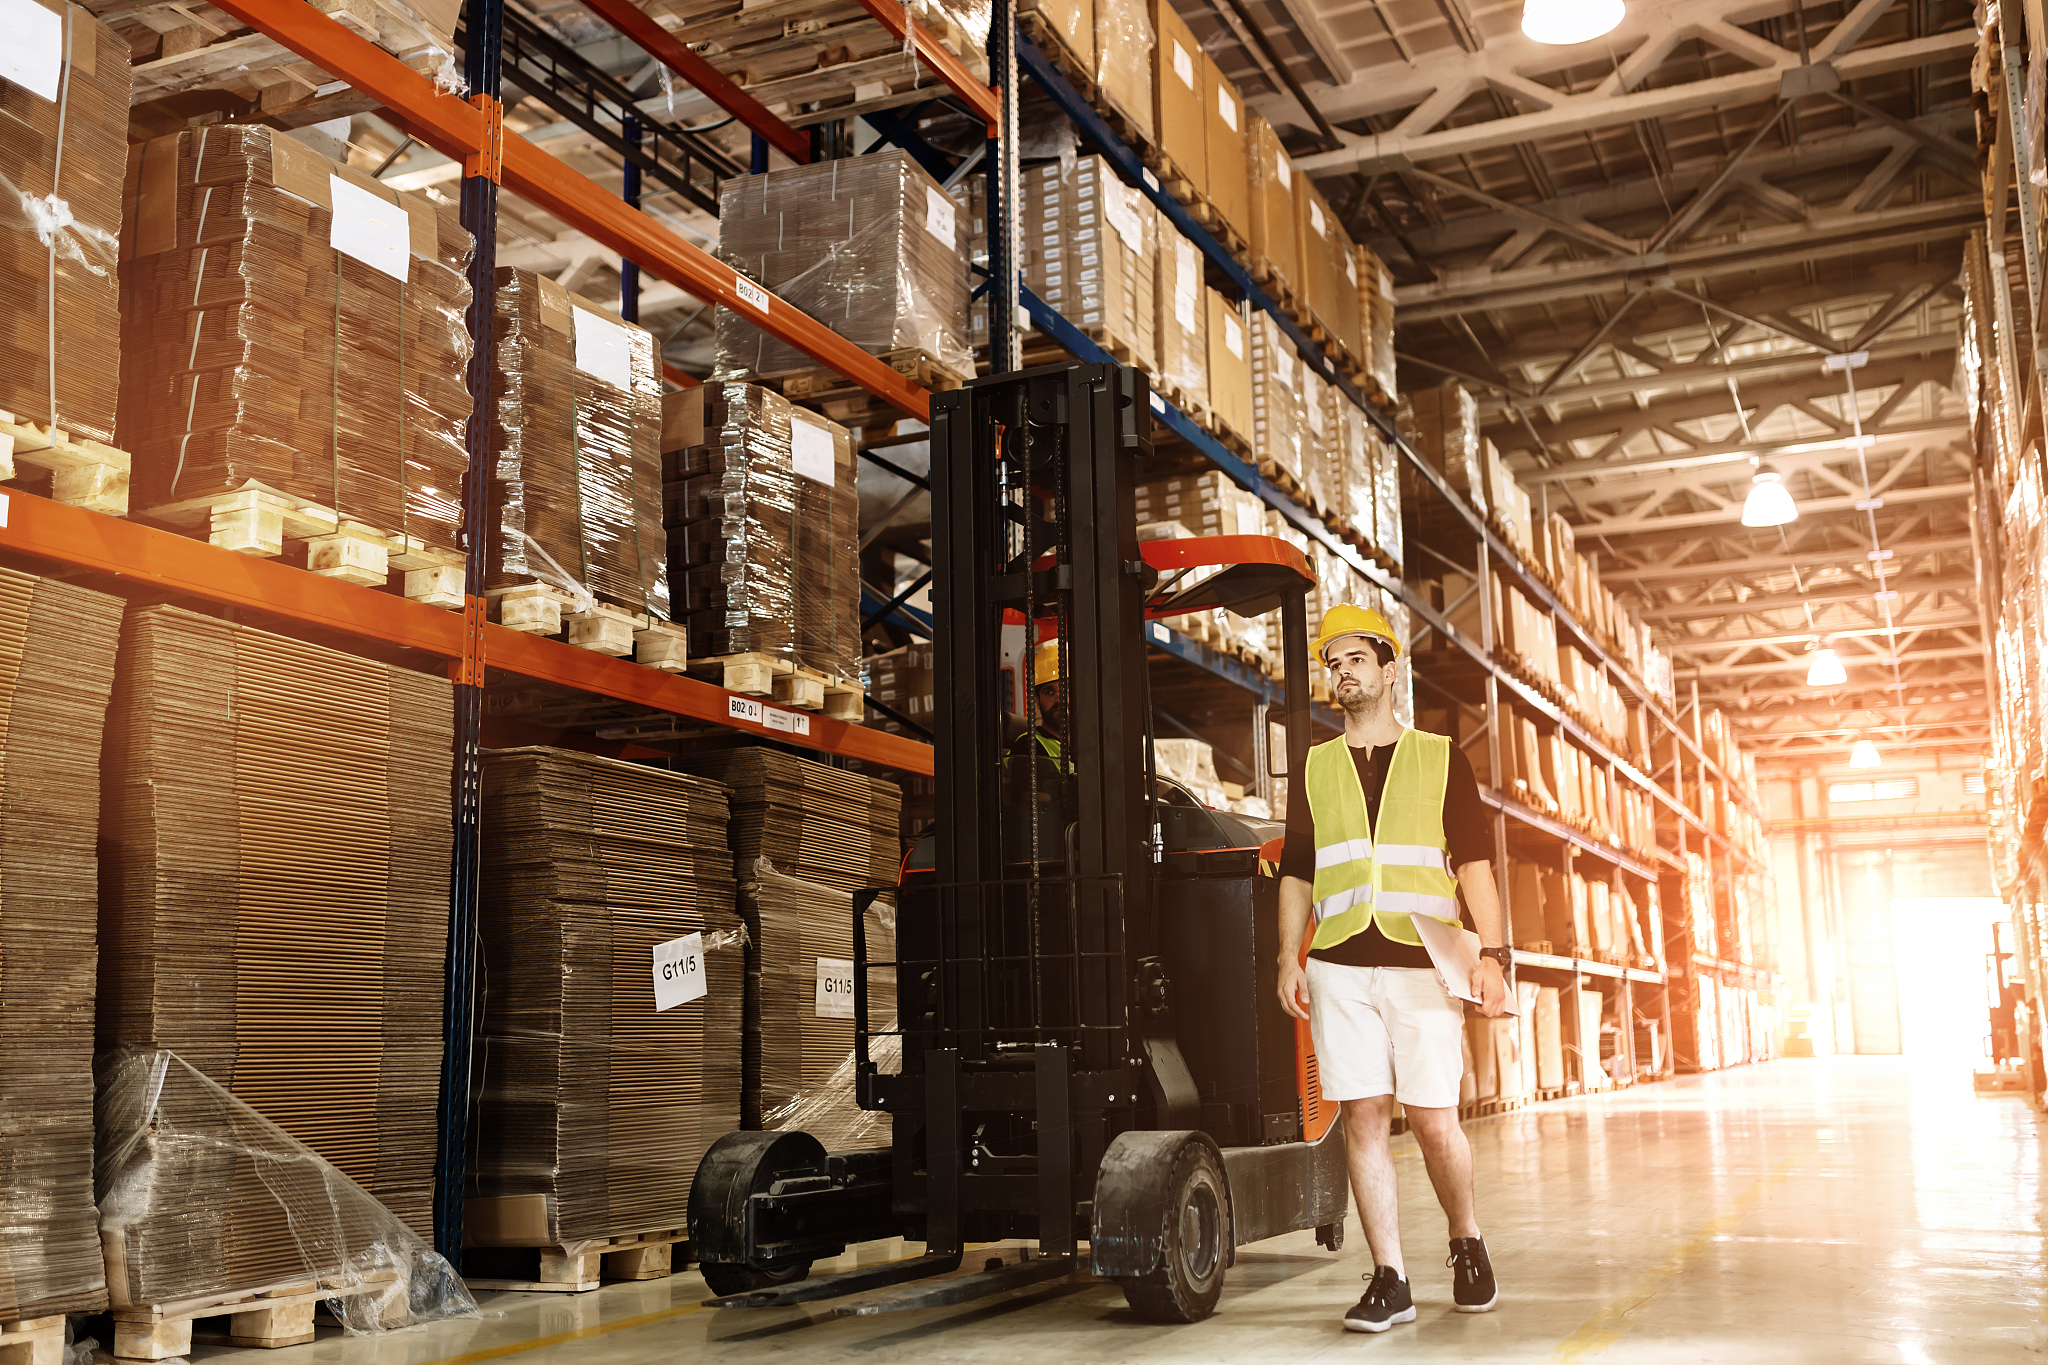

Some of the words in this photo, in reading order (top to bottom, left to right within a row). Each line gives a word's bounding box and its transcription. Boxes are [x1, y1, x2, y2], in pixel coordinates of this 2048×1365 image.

[739, 283, 752, 300] B02
[731, 700, 746, 713] B02
[662, 955, 696, 980] G11/5
[824, 977, 852, 994] G11/5
